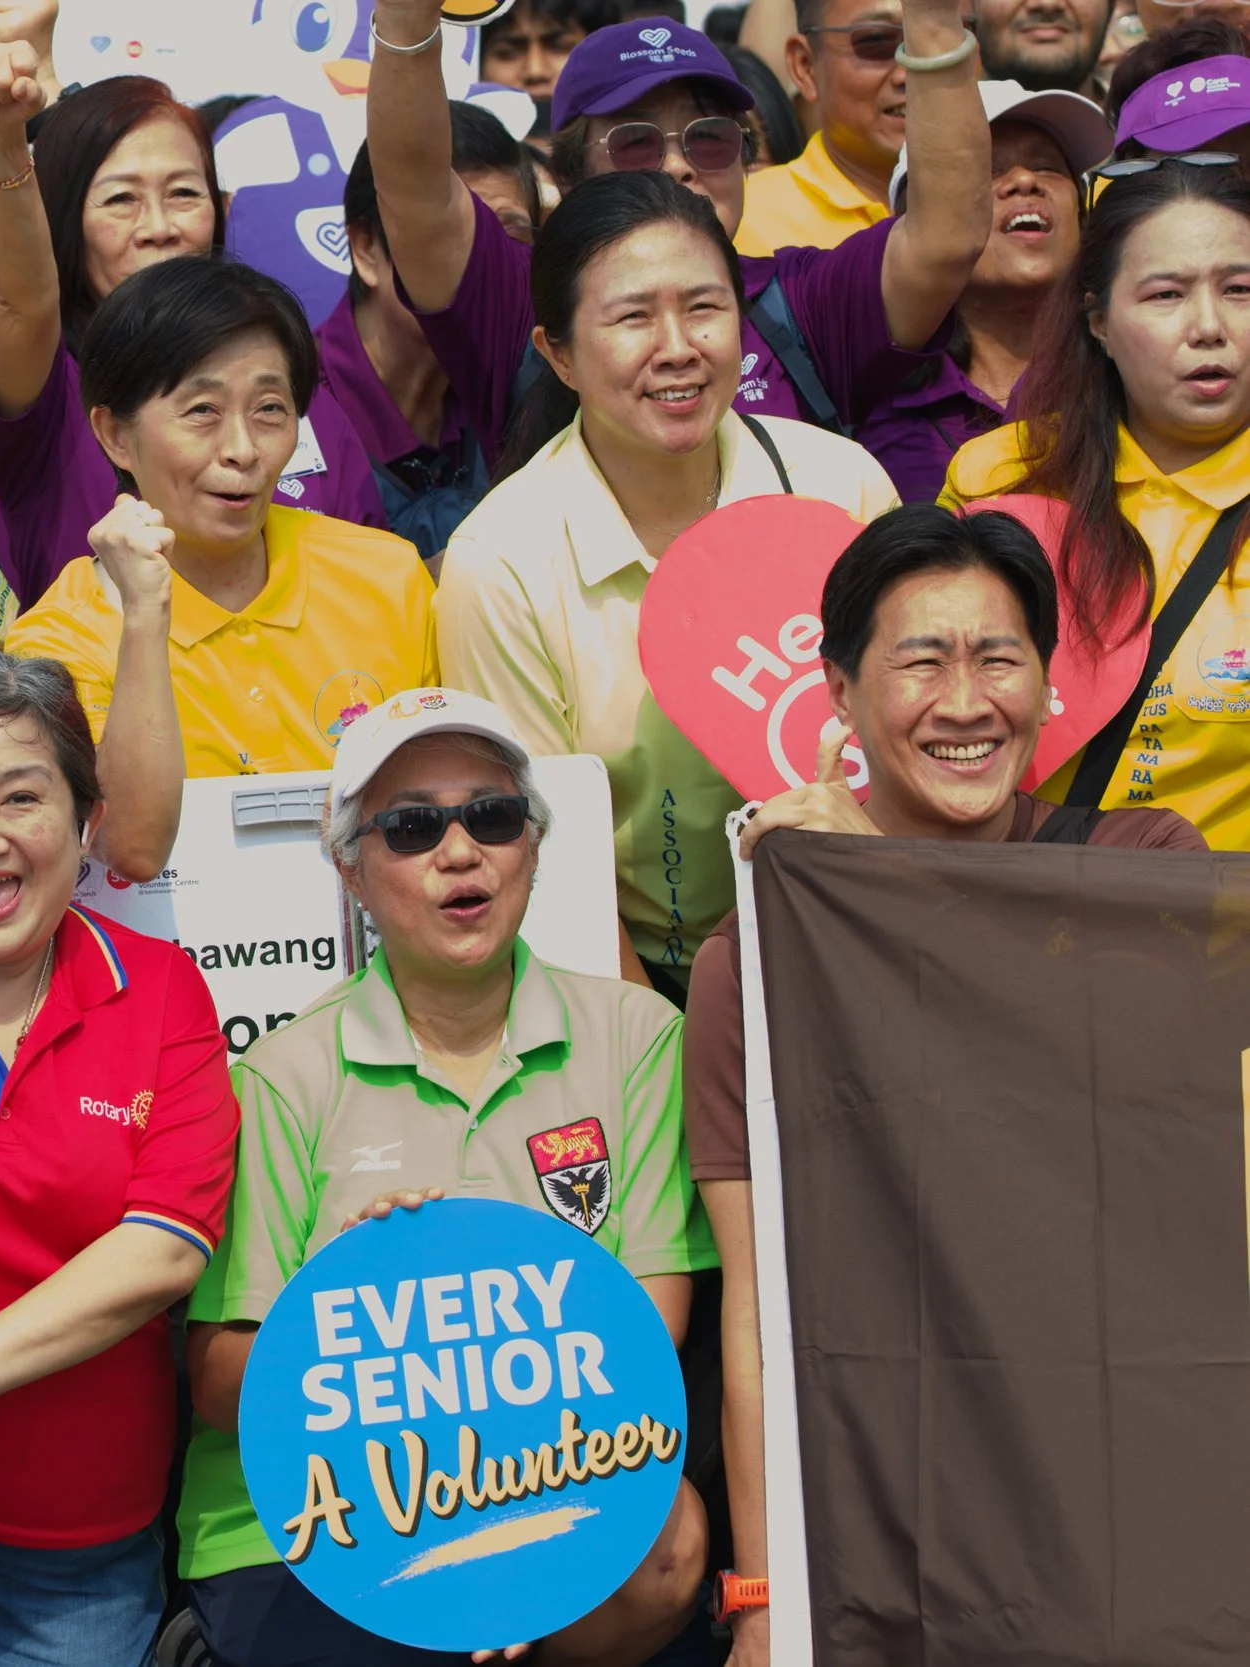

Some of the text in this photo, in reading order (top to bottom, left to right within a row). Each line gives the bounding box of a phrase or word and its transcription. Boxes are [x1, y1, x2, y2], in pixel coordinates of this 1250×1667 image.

[620, 46, 697, 61] Blossom Seeds
[711, 613, 824, 712] He
[1136, 752, 1159, 766] NA
[1142, 736, 1164, 751] TA
[174, 879, 200, 887] Centre
[173, 936, 336, 971] awang
[79, 1096, 130, 1126] Rotary
[312, 1259, 575, 1357] EVERY
[301, 1331, 614, 1433] SENIOR
[283, 1409, 682, 1565] A Volunteer
